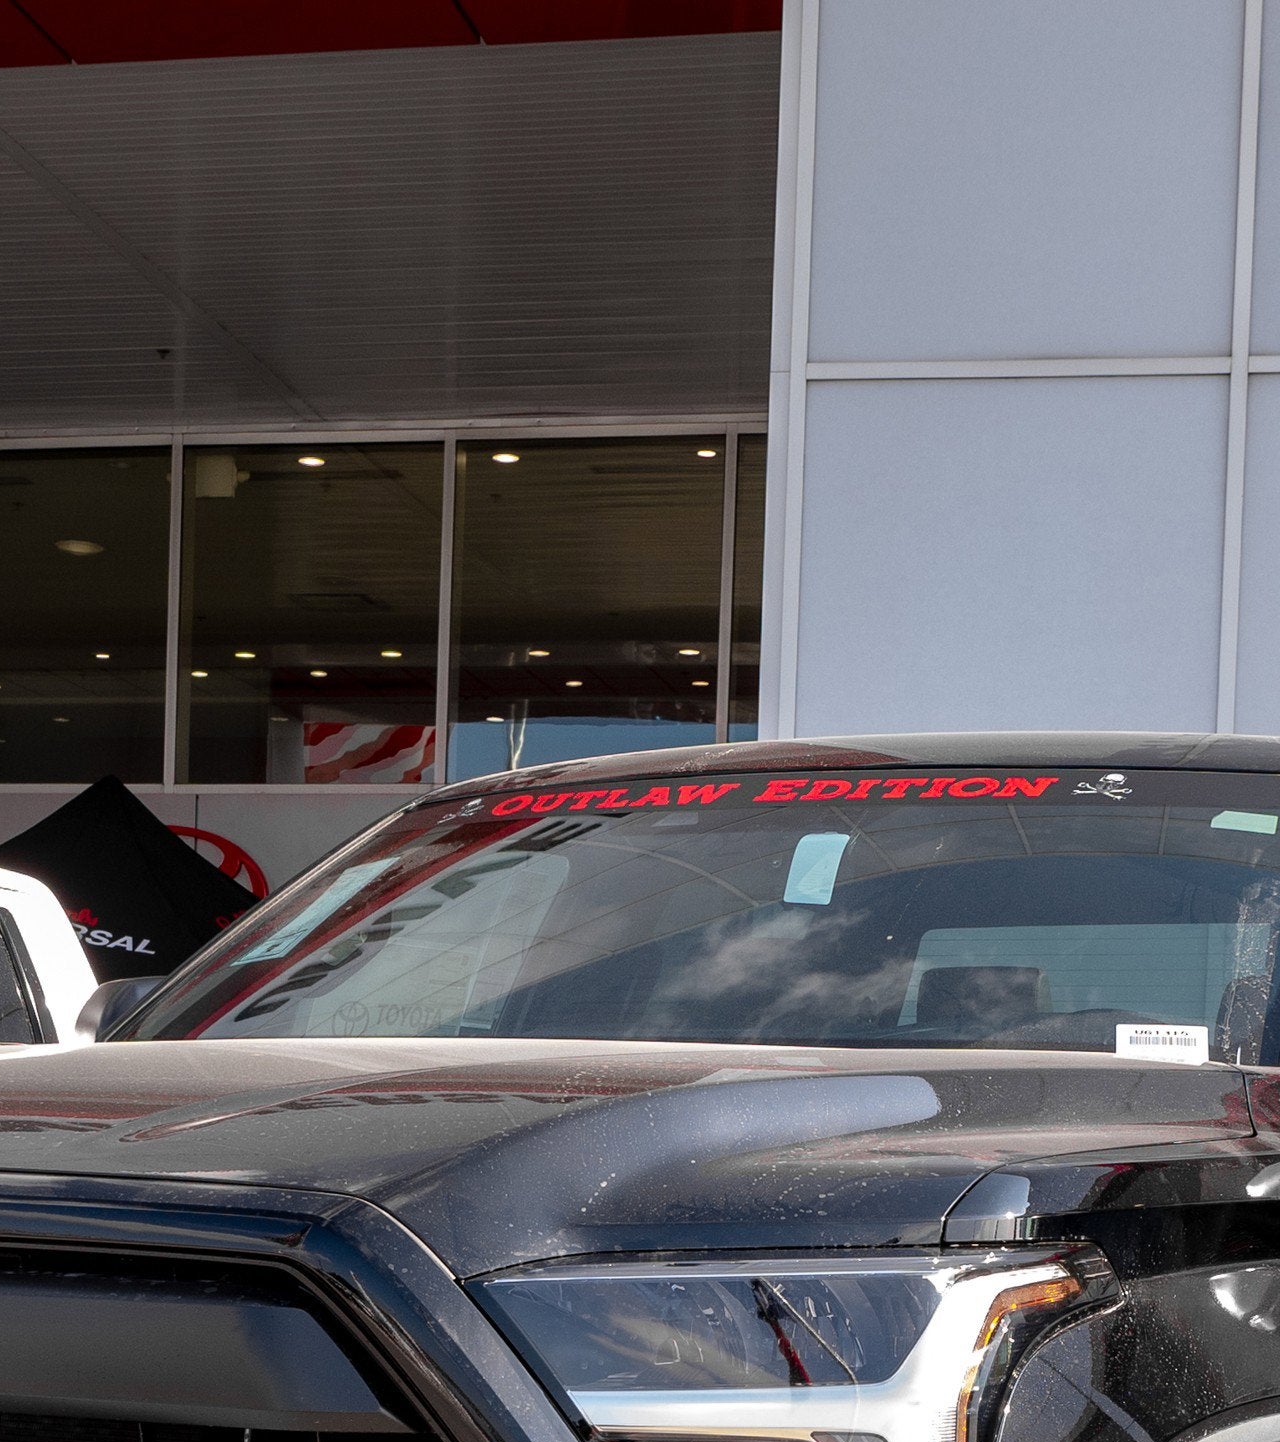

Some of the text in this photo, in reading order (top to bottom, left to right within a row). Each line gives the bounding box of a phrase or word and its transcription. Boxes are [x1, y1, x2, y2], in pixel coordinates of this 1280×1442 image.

[491, 777, 1060, 817] OUTLAW EDITION
[377, 1004, 442, 1030] TOYOTA
